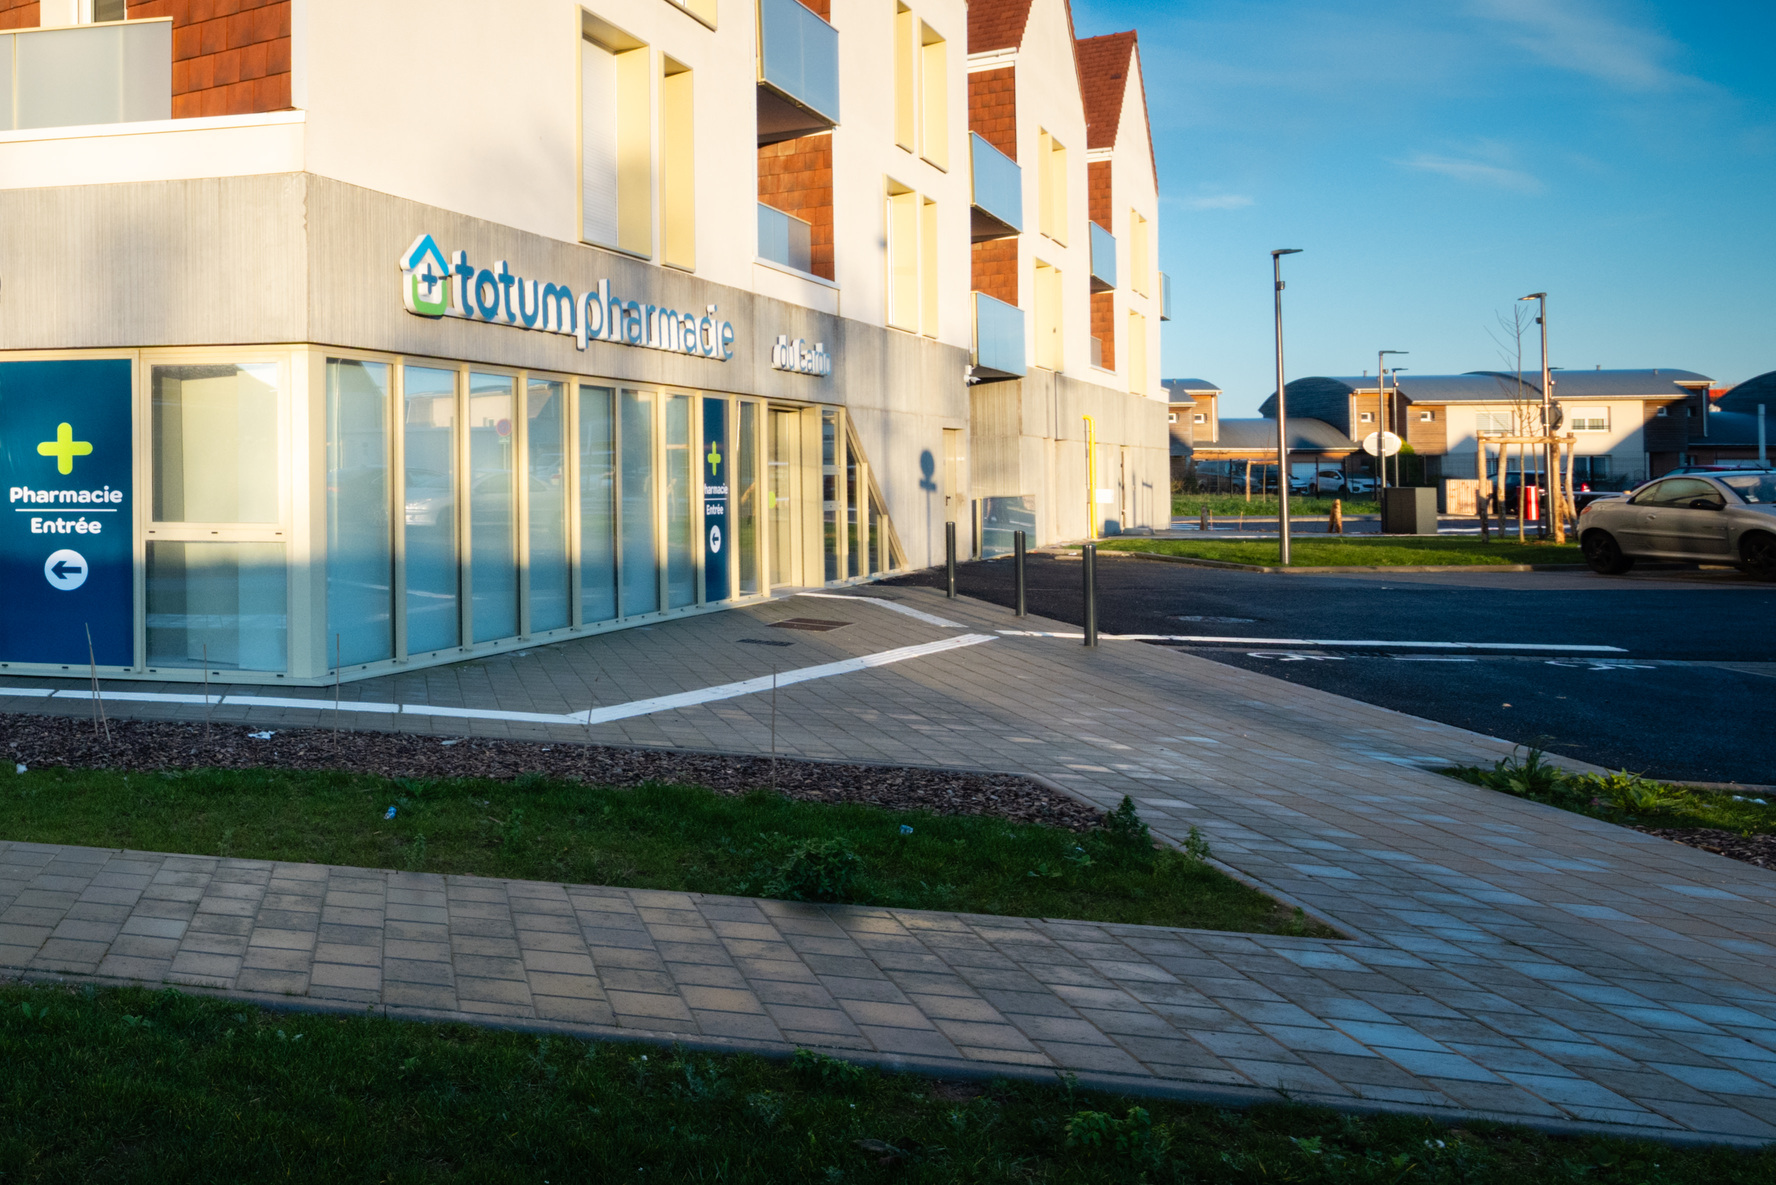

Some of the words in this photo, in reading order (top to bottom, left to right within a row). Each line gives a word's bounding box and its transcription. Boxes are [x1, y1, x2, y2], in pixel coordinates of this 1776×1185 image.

[452, 250, 576, 333] totum
[576, 278, 735, 361] pharmacie
[792, 338, 832, 376] Cardo
[9, 485, 123, 503] Pharmacie
[704, 482, 729, 495] harmacie
[706, 503, 724, 515] Entrée
[30, 516, 102, 534] Entrée
